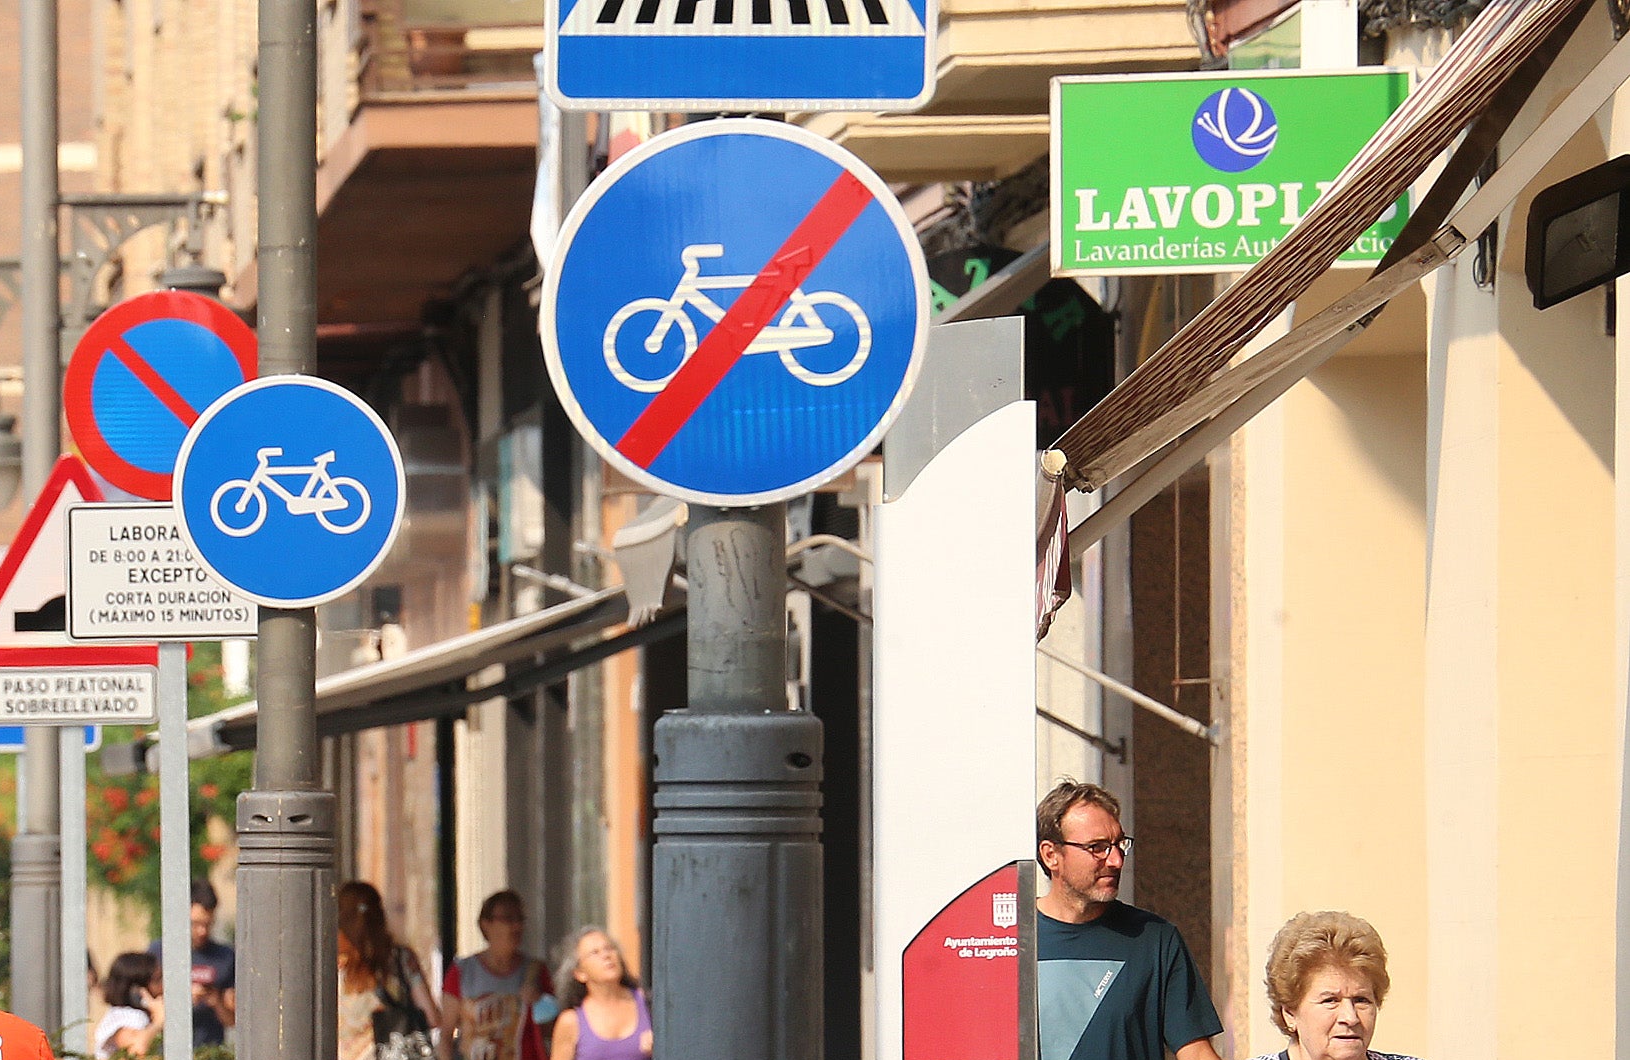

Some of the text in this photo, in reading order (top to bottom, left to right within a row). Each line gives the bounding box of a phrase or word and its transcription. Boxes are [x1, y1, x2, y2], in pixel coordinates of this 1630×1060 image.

[1075, 181, 1397, 232] LAVOPL
[1074, 236, 1227, 262] Lavanderías
[110, 526, 180, 541] LABORA
[89, 550, 194, 563] DE 8:00 A 21:0
[128, 567, 208, 583] EXCEPTO
[106, 591, 152, 605] CORTA
[161, 609, 174, 621] 15
[180, 607, 250, 622] MINUTOS)
[3, 677, 145, 693] PASO PEATONAL
[5, 697, 139, 713] SOBREELEVADO
[944, 936, 1018, 949] Ayuntamiento
[958, 947, 1018, 959] de Logroño
